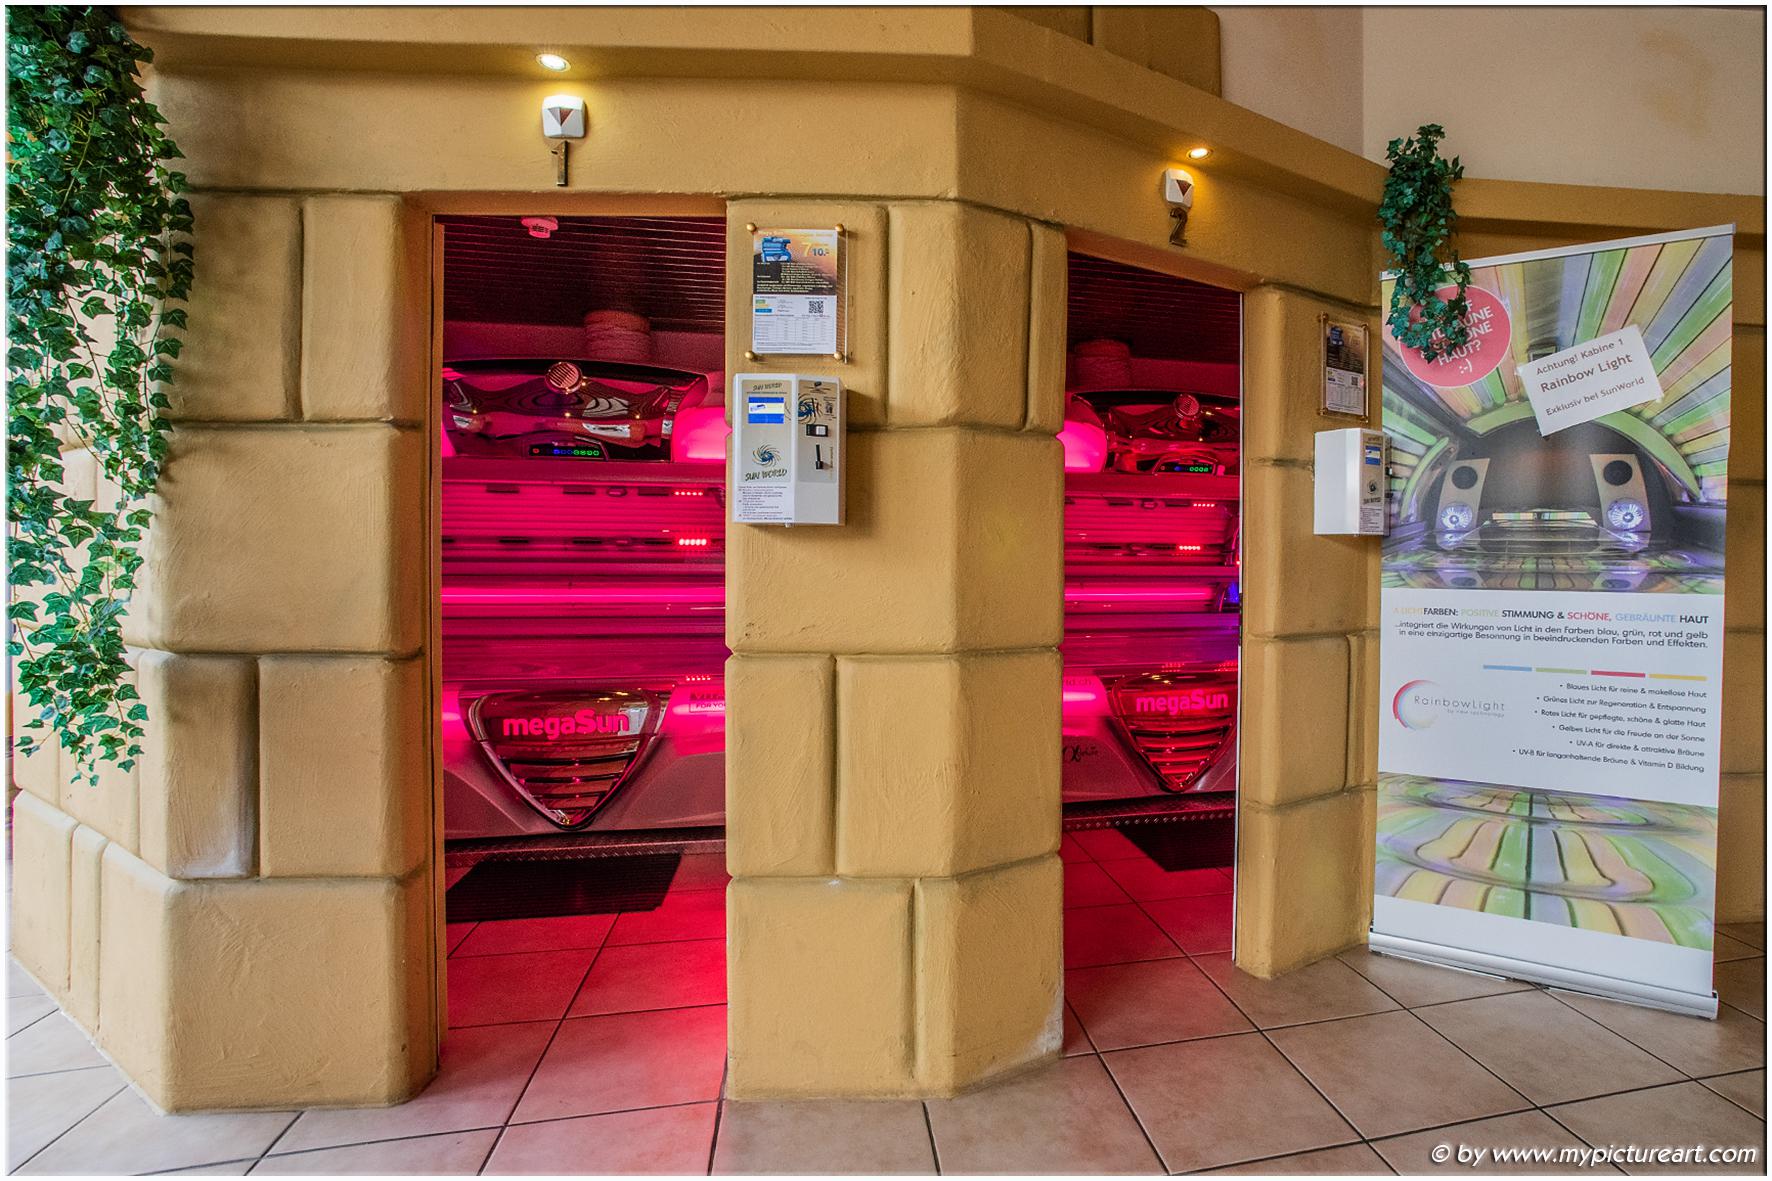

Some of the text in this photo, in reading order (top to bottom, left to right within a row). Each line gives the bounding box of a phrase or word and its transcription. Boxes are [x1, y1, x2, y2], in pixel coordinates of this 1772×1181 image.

[551, 140, 569, 187] 1
[1169, 207, 1188, 247] 2
[1437, 339, 1481, 366] HAUT?
[1536, 354, 1578, 375] Achtung!
[1580, 342, 1615, 359] Kabine
[1540, 354, 1633, 392] Rainbow Light
[1545, 376, 1645, 416] Exklusiv bei SunWorld
[1501, 609, 1554, 619] STIMMUNG
[1557, 610, 1565, 619] &
[1679, 614, 1709, 624] HAUT
[1427, 630, 1473, 640] einzigartige
[1475, 632, 1521, 642] Besonnung
[1523, 633, 1532, 641] in
[1533, 634, 1609, 645] beeindruckenden
[1612, 638, 1643, 646] Farben
[1647, 638, 1664, 647] und
[1667, 639, 1709, 648] Effekten.
[1436, 621, 1449, 629] die
[1450, 622, 1495, 632] Wirkungen
[1514, 624, 1533, 633] Licht
[1534, 624, 1543, 633] in
[1544, 624, 1562, 634] den
[1564, 626, 1595, 635] Farben
[1598, 627, 1619, 637] blau,
[1622, 629, 1646, 639] grün,
[1649, 630, 1662, 638] rot
[1664, 630, 1684, 639] und
[1686, 631, 1709, 642] gelb
[1566, 682, 1590, 691] Blaues
[1591, 684, 1607, 692] Licht
[1648, 689, 1686, 697] makellose
[1688, 690, 1707, 698] Haut
[1136, 689, 1229, 716] megaSun
[1414, 695, 1505, 712] RainbowLight
[1543, 695, 1568, 704] Grünes
[1569, 697, 1585, 705] Licht
[1599, 699, 1647, 708] Regeneration
[1657, 702, 1707, 714] Entspannung
[503, 709, 629, 740] megaSun
[1541, 709, 1560, 717] Rotes
[1627, 716, 1653, 724] schöne
[1663, 718, 1685, 727] glatte
[1687, 719, 1706, 728] Haut
[1559, 724, 1583, 733] Gelbes
[1627, 730, 1652, 738] Freude
[1666, 732, 1679, 741] der
[1681, 734, 1705, 742] Sonne
[1606, 742, 1631, 751] direkte
[1641, 746, 1675, 755] attraktive
[1678, 748, 1705, 757] Bräune
[1546, 751, 1601, 763] langanhaltende
[1603, 756, 1628, 765] Bräune
[1638, 760, 1665, 768] Vitamin
[1675, 763, 1705, 774] Bildung
